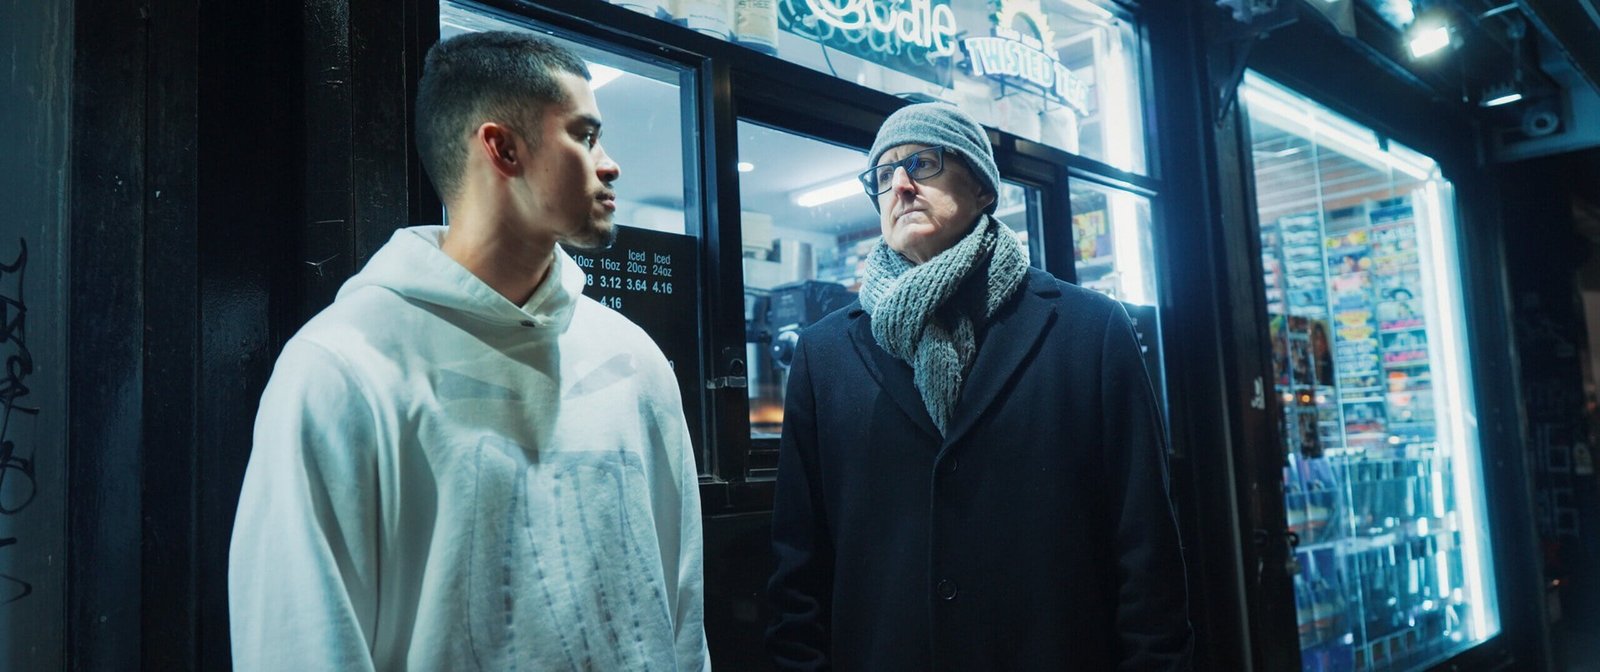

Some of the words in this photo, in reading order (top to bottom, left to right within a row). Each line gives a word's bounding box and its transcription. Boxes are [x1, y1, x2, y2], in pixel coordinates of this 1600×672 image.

[964, 37, 1054, 88] TWISTED
[573, 254, 594, 268] 10oz
[600, 257, 621, 271] 16oz
[626, 261, 647, 274] 20oz
[652, 264, 672, 277] 24oz
[628, 249, 646, 262] Iced
[654, 252, 671, 265] Iced
[600, 275, 621, 289] 3.12
[626, 278, 647, 291] 3.64
[652, 281, 673, 294] 4.16
[600, 295, 622, 309] 4.16
